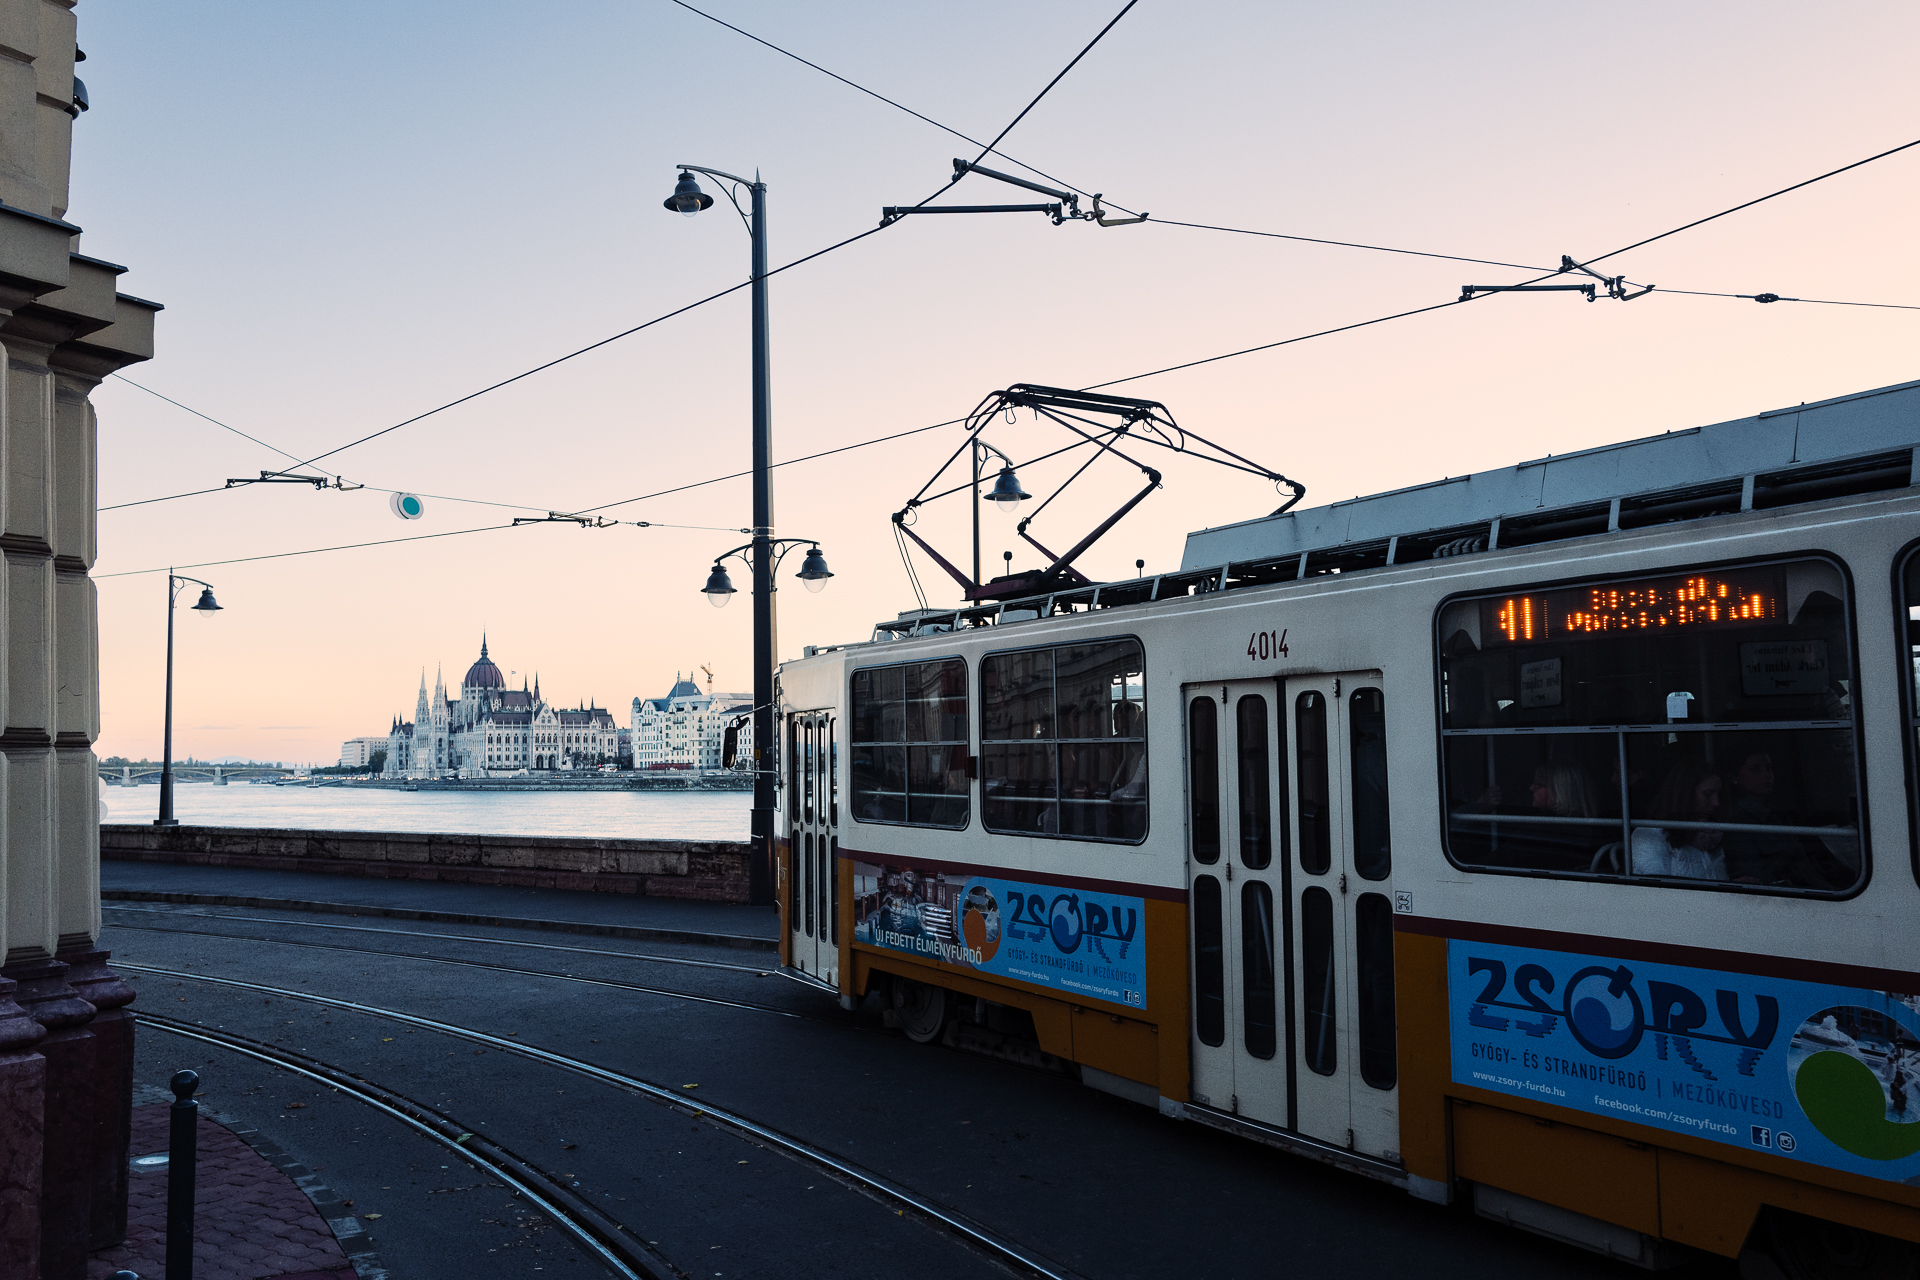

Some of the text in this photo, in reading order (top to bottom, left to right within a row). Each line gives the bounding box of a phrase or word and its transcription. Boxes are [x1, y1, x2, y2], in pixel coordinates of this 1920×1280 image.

[1247, 628, 1289, 661] 4014
[875, 926, 982, 965] ÚJ FEDETT ÉLMÉNYFÜRDŐ
[1008, 947, 1137, 985] GYÓGY- ÉS STRANDFÜRDŐ MEZŐKÖVESD
[1008, 967, 1050, 981] www.zsory-furdo.hu
[1060, 977, 1119, 997] facebook.com/zsoryfurdo
[1471, 1042, 1783, 1120] GYÓGY- ÉS STRANDFÜRDŐ MEZŐKÖVESD
[1472, 1070, 1566, 1098] www.zsory-furdo.hu
[1594, 1095, 1737, 1135] facebook.com/zsoryfurdo
